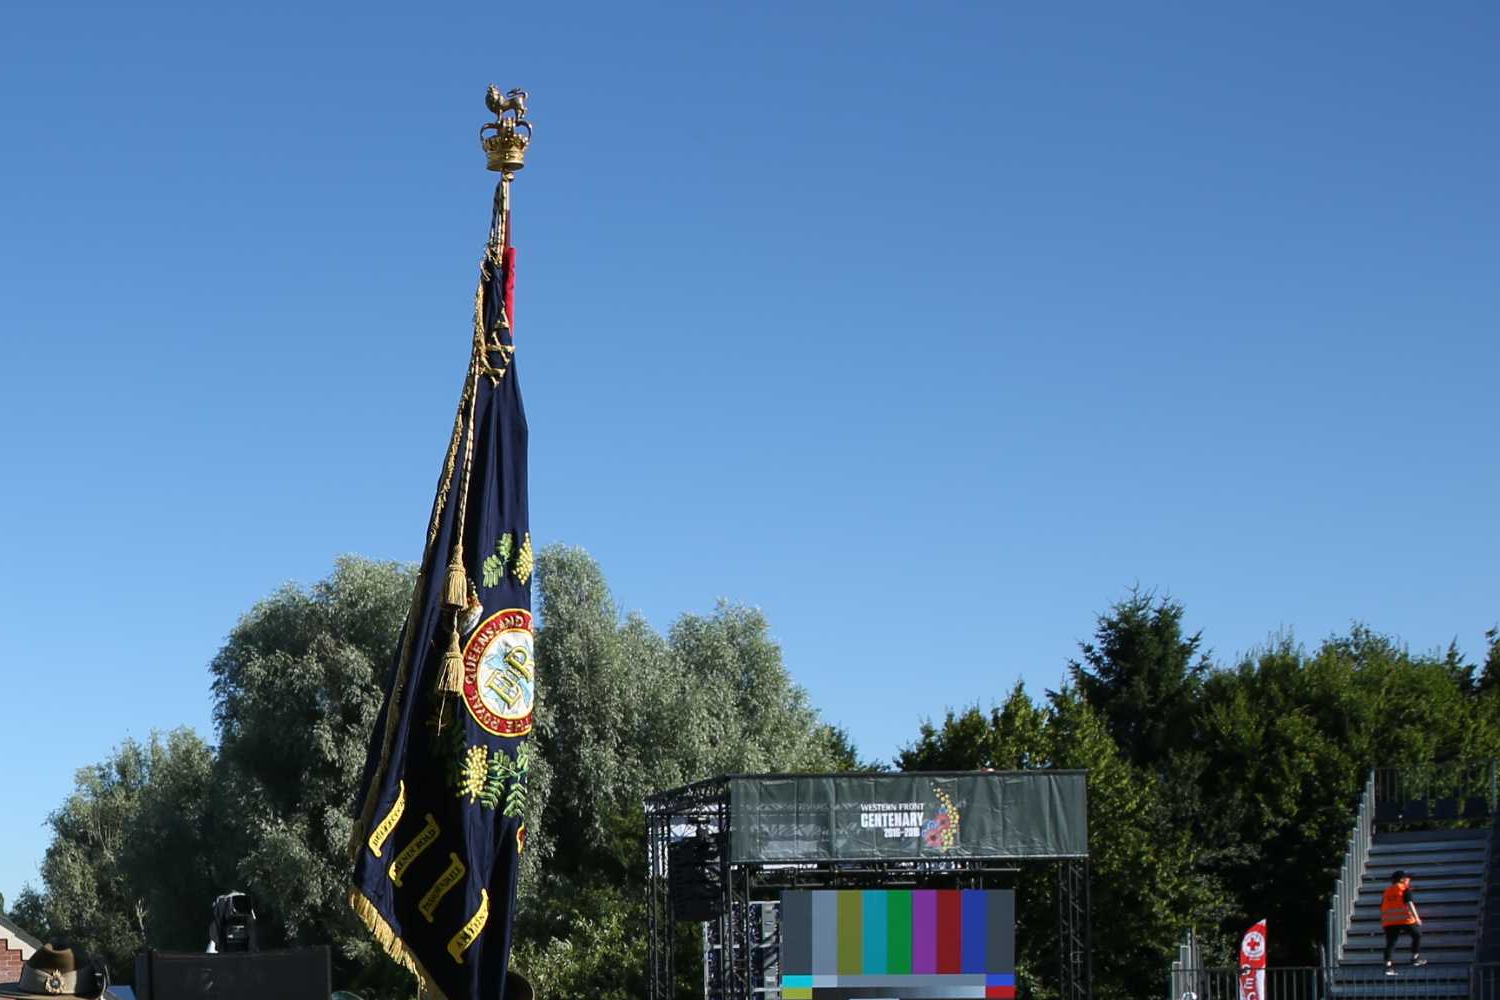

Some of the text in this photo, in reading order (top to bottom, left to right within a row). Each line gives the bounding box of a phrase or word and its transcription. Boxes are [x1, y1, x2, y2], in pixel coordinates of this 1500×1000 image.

[465, 614, 524, 685] QUEENSLAND
[860, 802, 924, 812] WESTERN FRONT
[860, 811, 924, 828] CENTENARY
